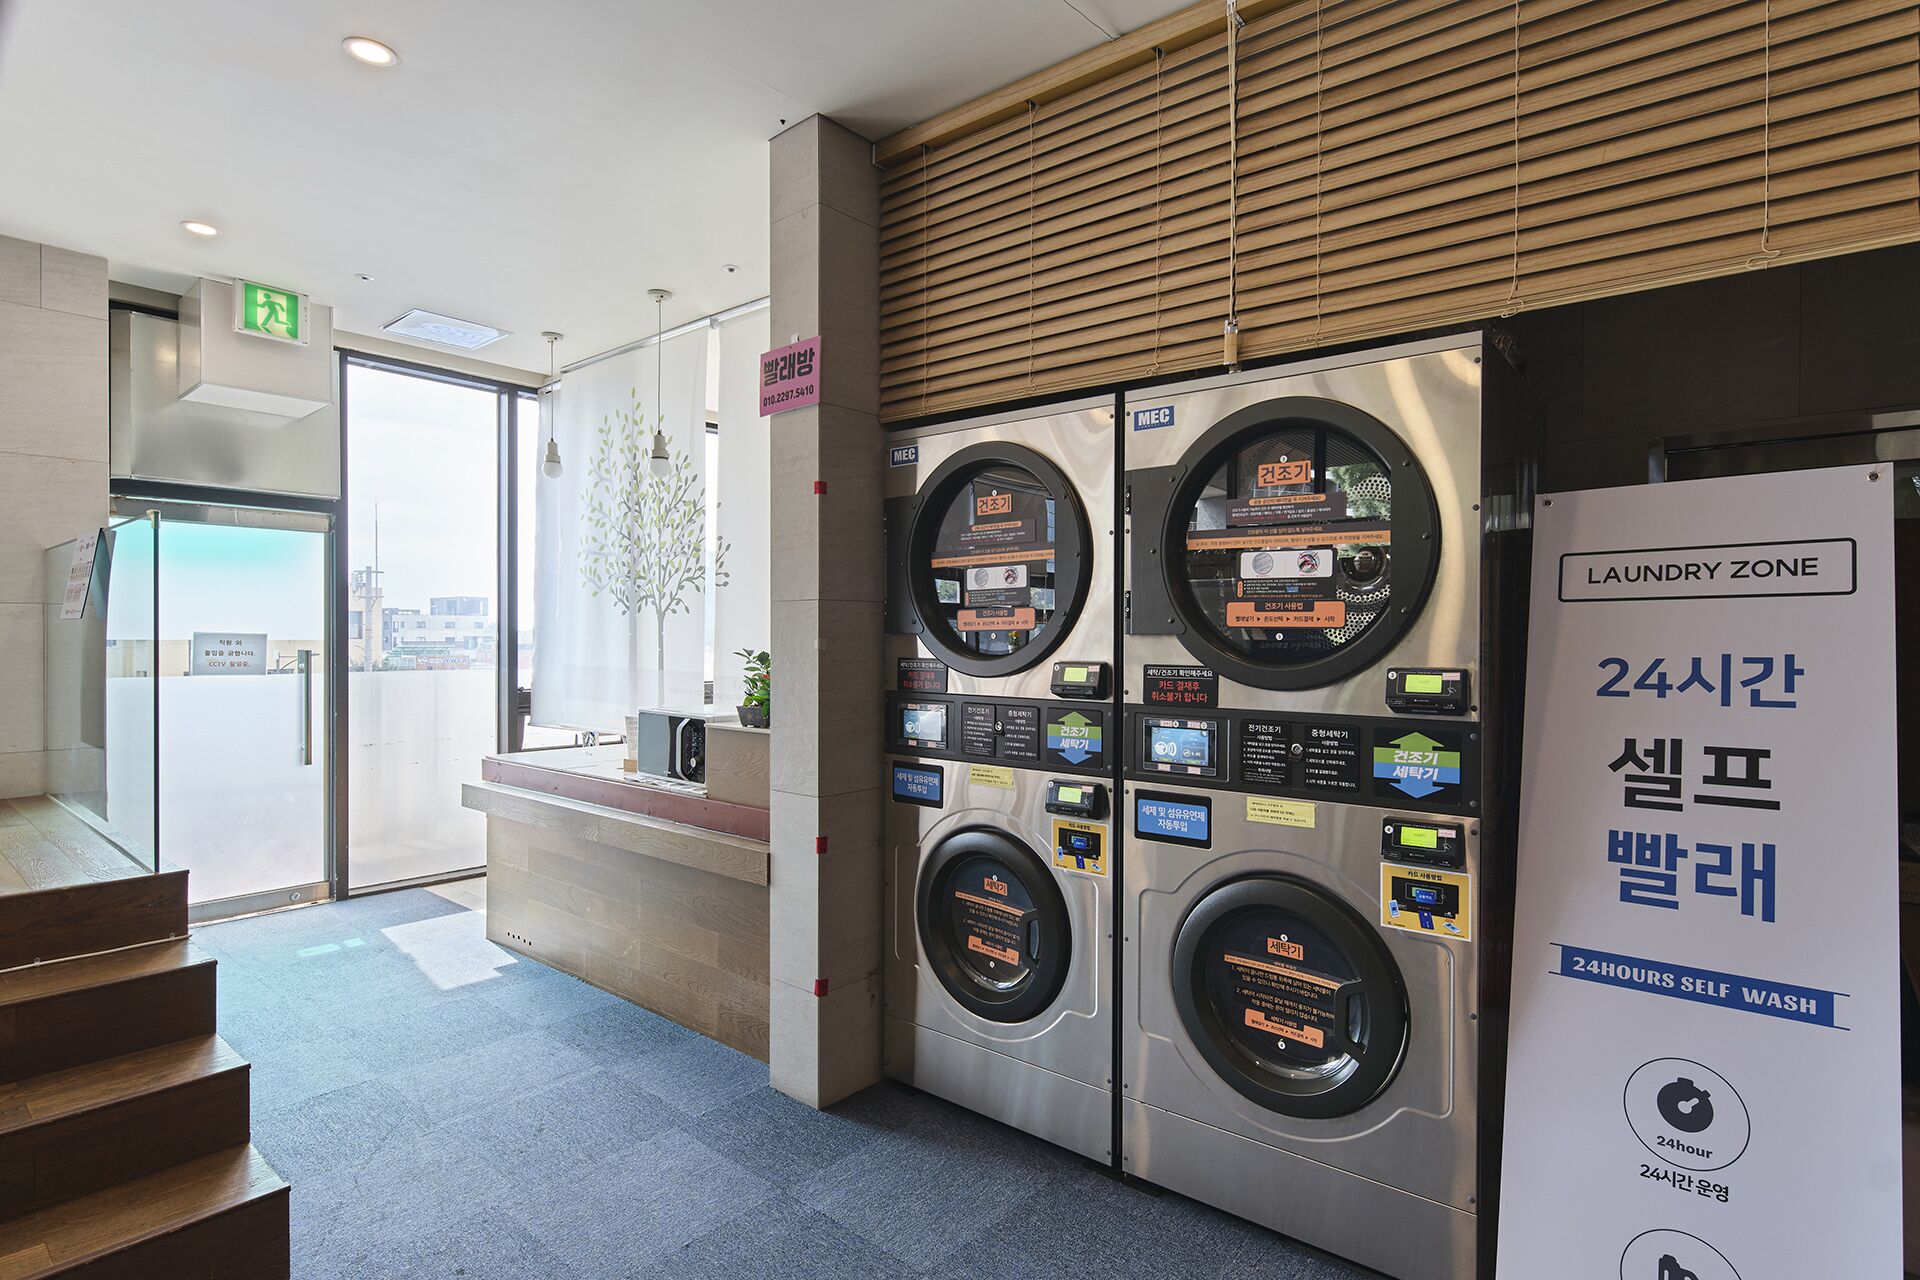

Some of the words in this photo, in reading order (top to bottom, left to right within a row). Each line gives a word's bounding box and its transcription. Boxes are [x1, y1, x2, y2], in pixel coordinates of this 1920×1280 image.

[764, 347, 815, 387] 빨래방
[763, 384, 814, 407] 010.2297.5410
[1138, 408, 1170, 426] MEC
[894, 448, 916, 462] MEC
[1260, 462, 1309, 484] 건조기
[978, 494, 1011, 513] 건조기
[1588, 562, 1722, 584] LAUNDRY
[1730, 558, 1819, 579] ZONE
[1264, 602, 1284, 610] 건조기
[1285, 602, 1304, 610] 사용법
[1147, 668, 1178, 677] 세탁/건조기
[1180, 669, 1213, 677] 확인해주세요
[1159, 680, 1174, 690] 카드
[1596, 654, 1804, 708] 24시간
[1152, 692, 1182, 702] 취소불가
[1184, 692, 1208, 703] 합니다
[1060, 726, 1088, 738] 건조기
[1248, 724, 1281, 734] 전기건조기
[1311, 729, 1348, 738] 중형세탁기
[1060, 738, 1088, 750] 세탁기
[1394, 750, 1438, 765] 건조기
[1392, 766, 1438, 780] 세탁기
[1608, 738, 1780, 812] 셀프
[1142, 805, 1157, 816] 세제
[1158, 806, 1166, 817] 및
[1158, 818, 1188, 832] 자동투입
[1408, 869, 1418, 878] 카드
[1608, 829, 1776, 923] 빨래
[986, 880, 1006, 894] 세탁기
[1270, 941, 1300, 958] 세탁기
[1572, 956, 1675, 988] 24HOURS
[1681, 976, 1730, 998] SELF
[1742, 988, 1817, 1014] WASH
[1656, 1135, 1712, 1158] 24hour
[1640, 1164, 1694, 1192] 24시간
[1696, 1179, 1728, 1203] 운영
